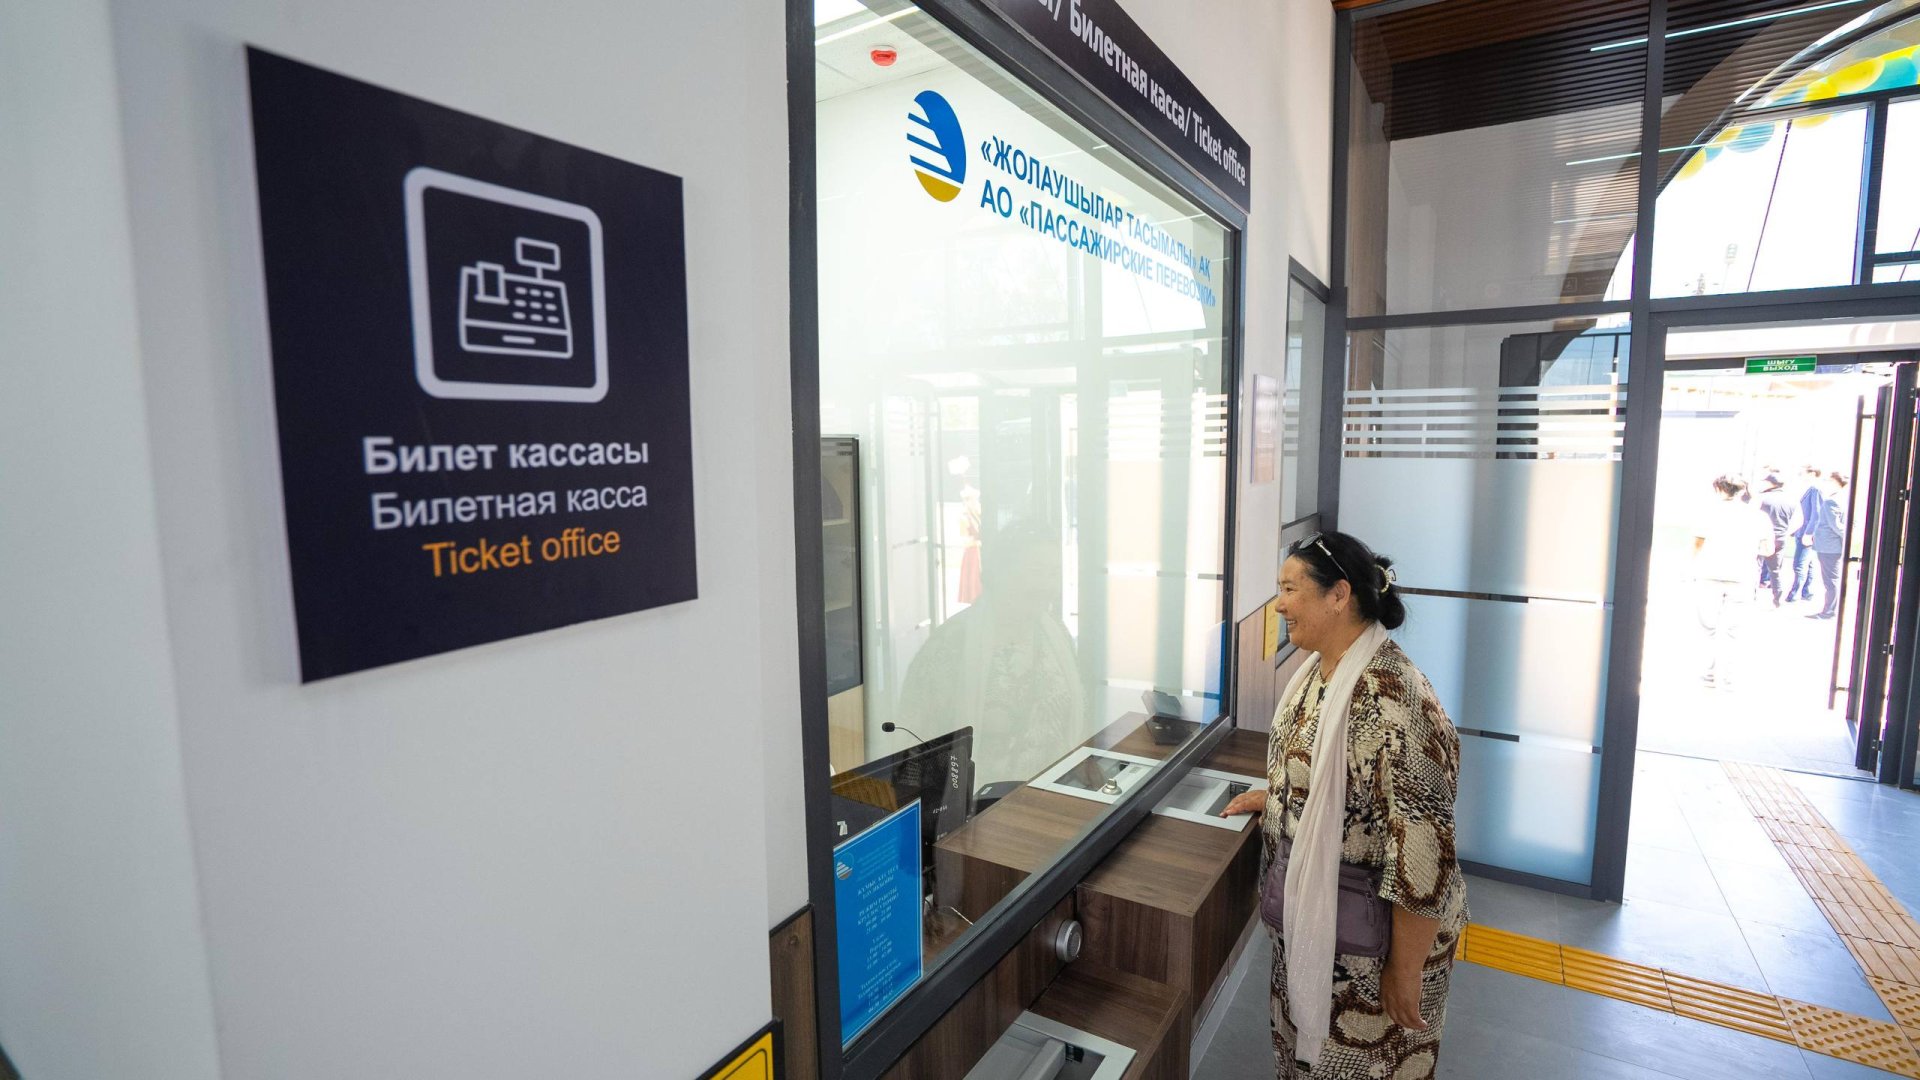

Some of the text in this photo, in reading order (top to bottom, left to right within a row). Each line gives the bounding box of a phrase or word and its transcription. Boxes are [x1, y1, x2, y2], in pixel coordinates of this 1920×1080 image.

[1070, 0, 1148, 98] Билетная
[1192, 110, 1222, 165] Ticket
[1223, 147, 1246, 186] office
[981, 135, 1123, 229] «ЖОЛАУШЫЛАР
[980, 179, 1013, 218] АО
[1019, 200, 1153, 280] «ПАССАЖИРСКИЕ
[363, 436, 649, 475] Билет кассасы
[371, 484, 648, 531] Билетная касса
[422, 526, 621, 578] Ticket office
